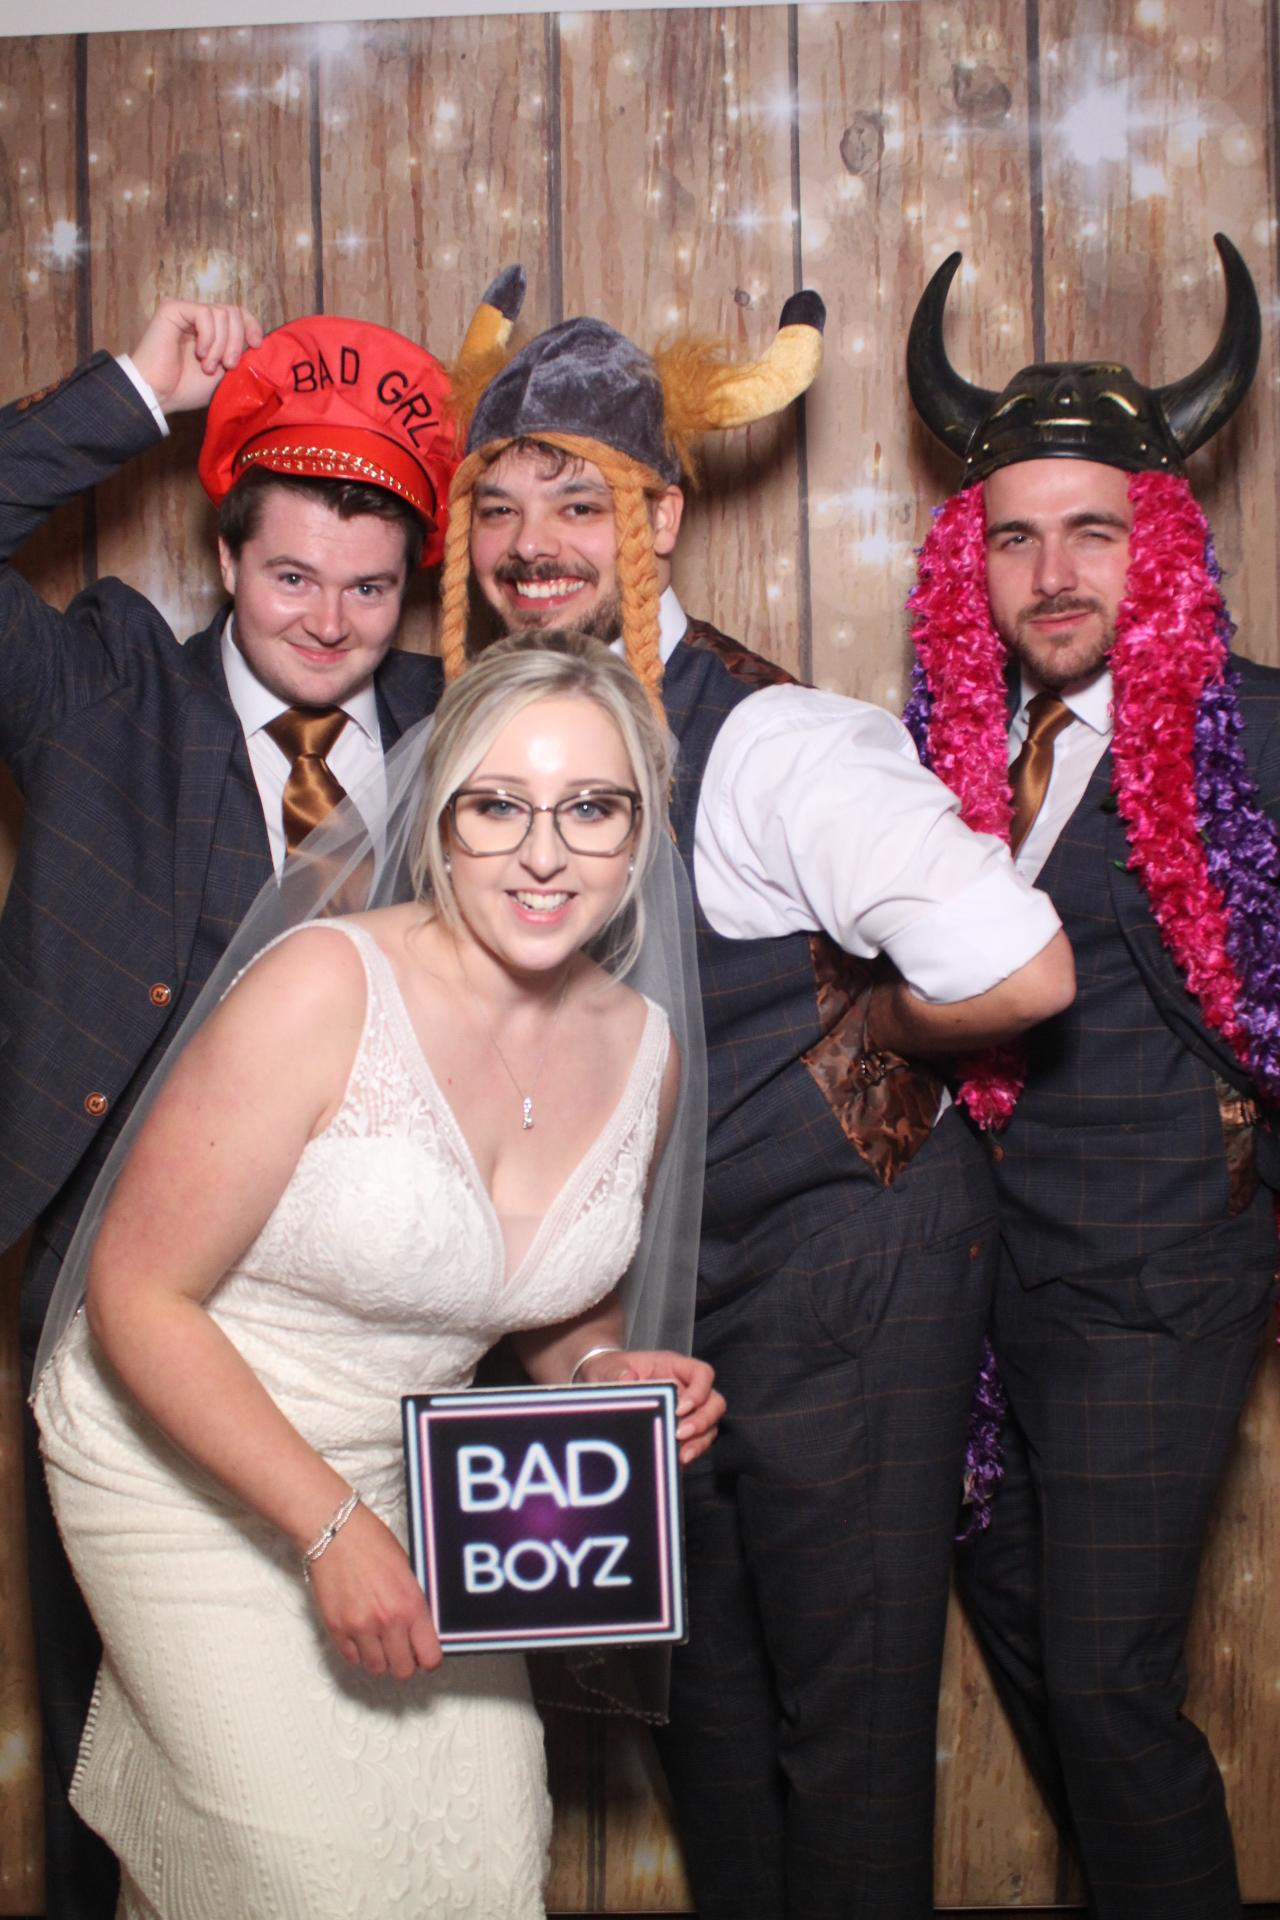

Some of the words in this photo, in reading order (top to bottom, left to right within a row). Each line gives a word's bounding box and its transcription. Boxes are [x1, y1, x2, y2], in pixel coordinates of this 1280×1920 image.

[291, 345, 361, 393] BAD
[456, 1439, 631, 1513] BAD
[463, 1535, 633, 1594] BOYZ
